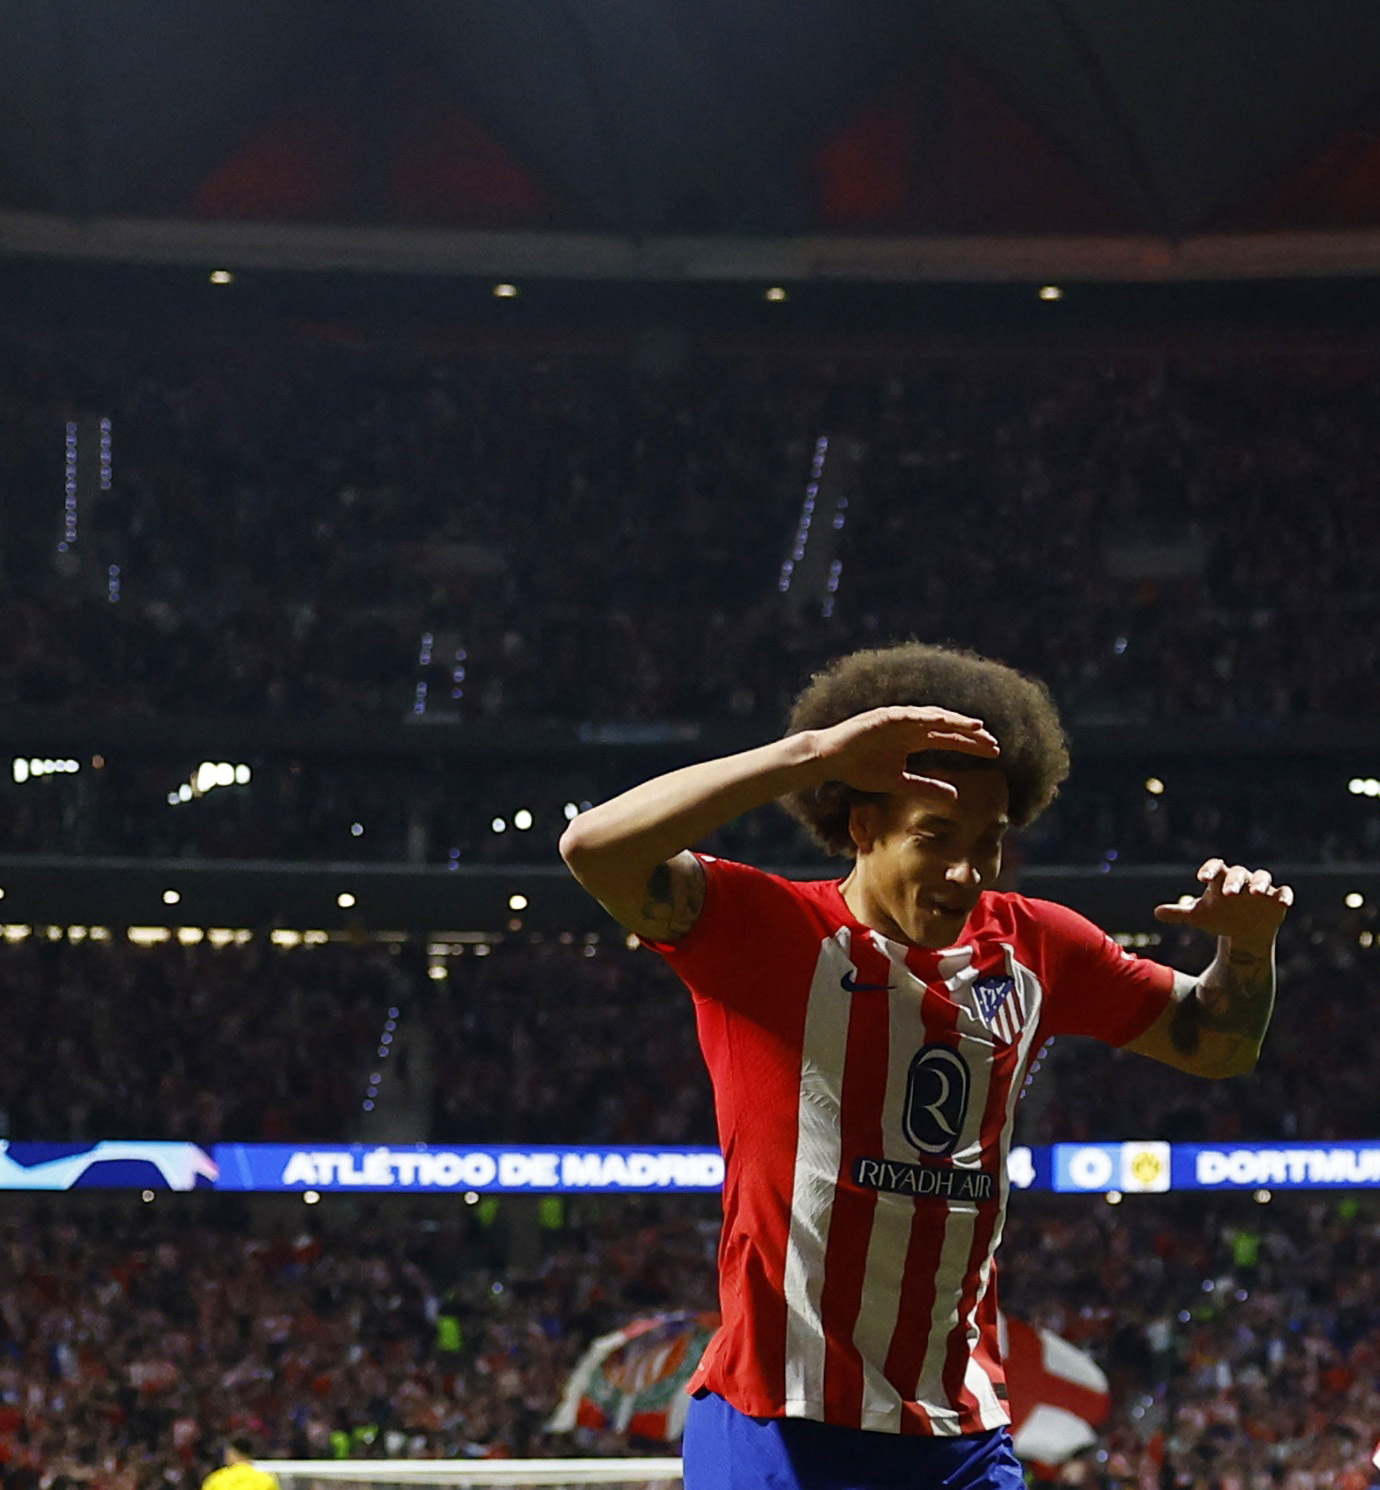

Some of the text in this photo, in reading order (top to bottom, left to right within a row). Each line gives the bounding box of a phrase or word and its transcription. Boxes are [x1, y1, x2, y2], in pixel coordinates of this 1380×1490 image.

[283, 1147, 726, 1186] ATLÉTICO DE MADRID
[858, 1159, 992, 1199] RIYADH AIR
